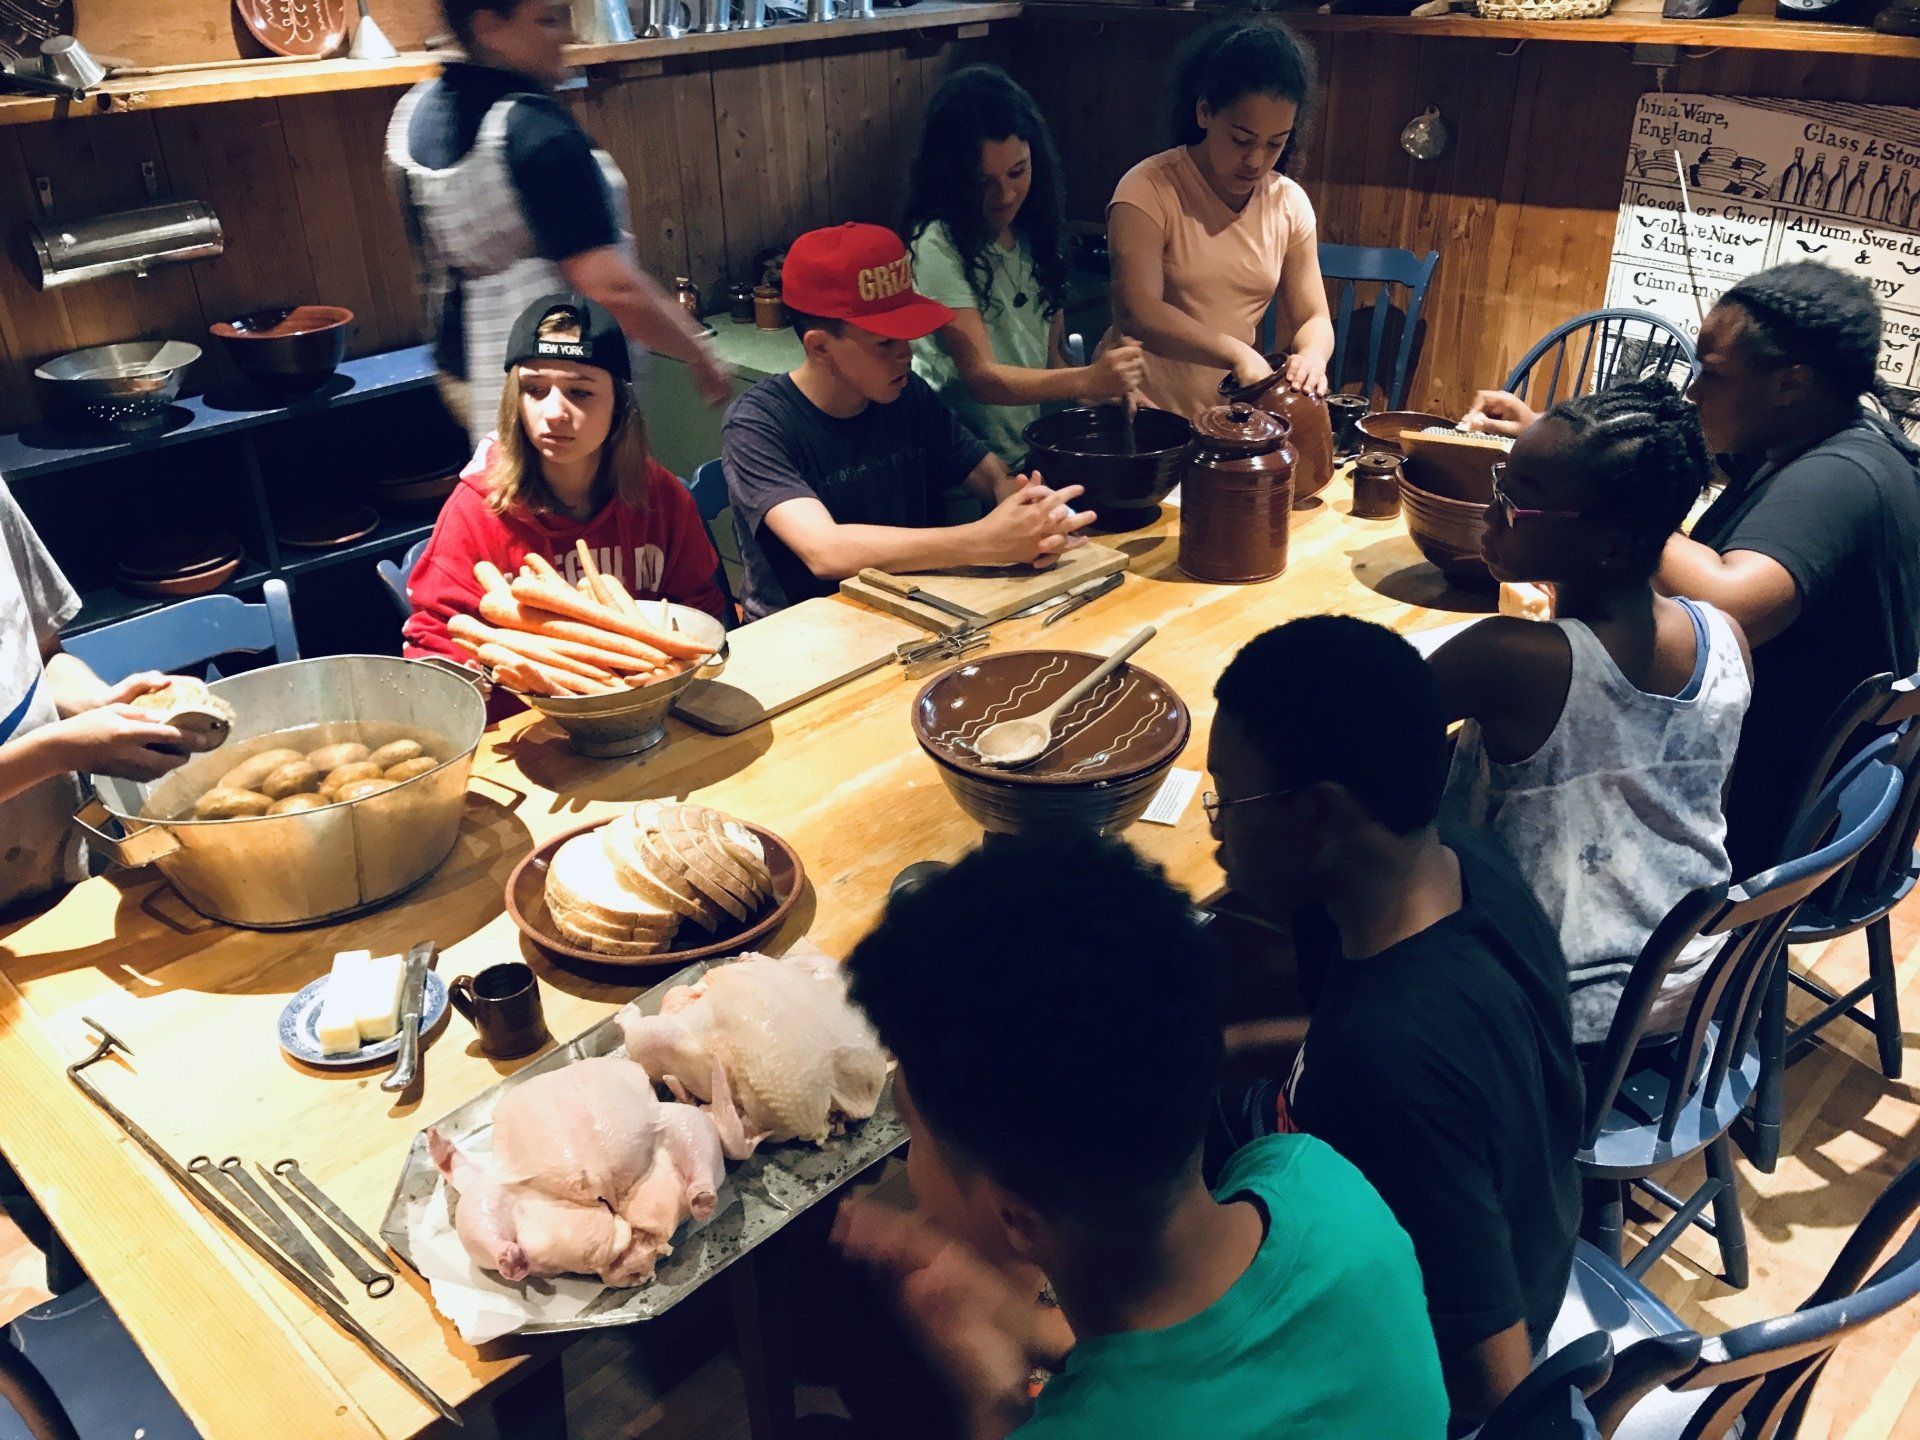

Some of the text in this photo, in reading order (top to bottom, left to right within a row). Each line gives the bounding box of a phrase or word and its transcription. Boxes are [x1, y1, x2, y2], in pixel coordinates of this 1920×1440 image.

[1640, 98, 1729, 129] hina Ware,
[1639, 117, 1713, 145] England
[1804, 123, 1859, 152] Glass
[1863, 140, 1877, 157] &
[1637, 193, 1769, 226] Cocoa or Choc
[1707, 225, 1741, 246] Nut
[1855, 250, 1871, 264] &
[539, 343, 583, 356] NEW YORK
